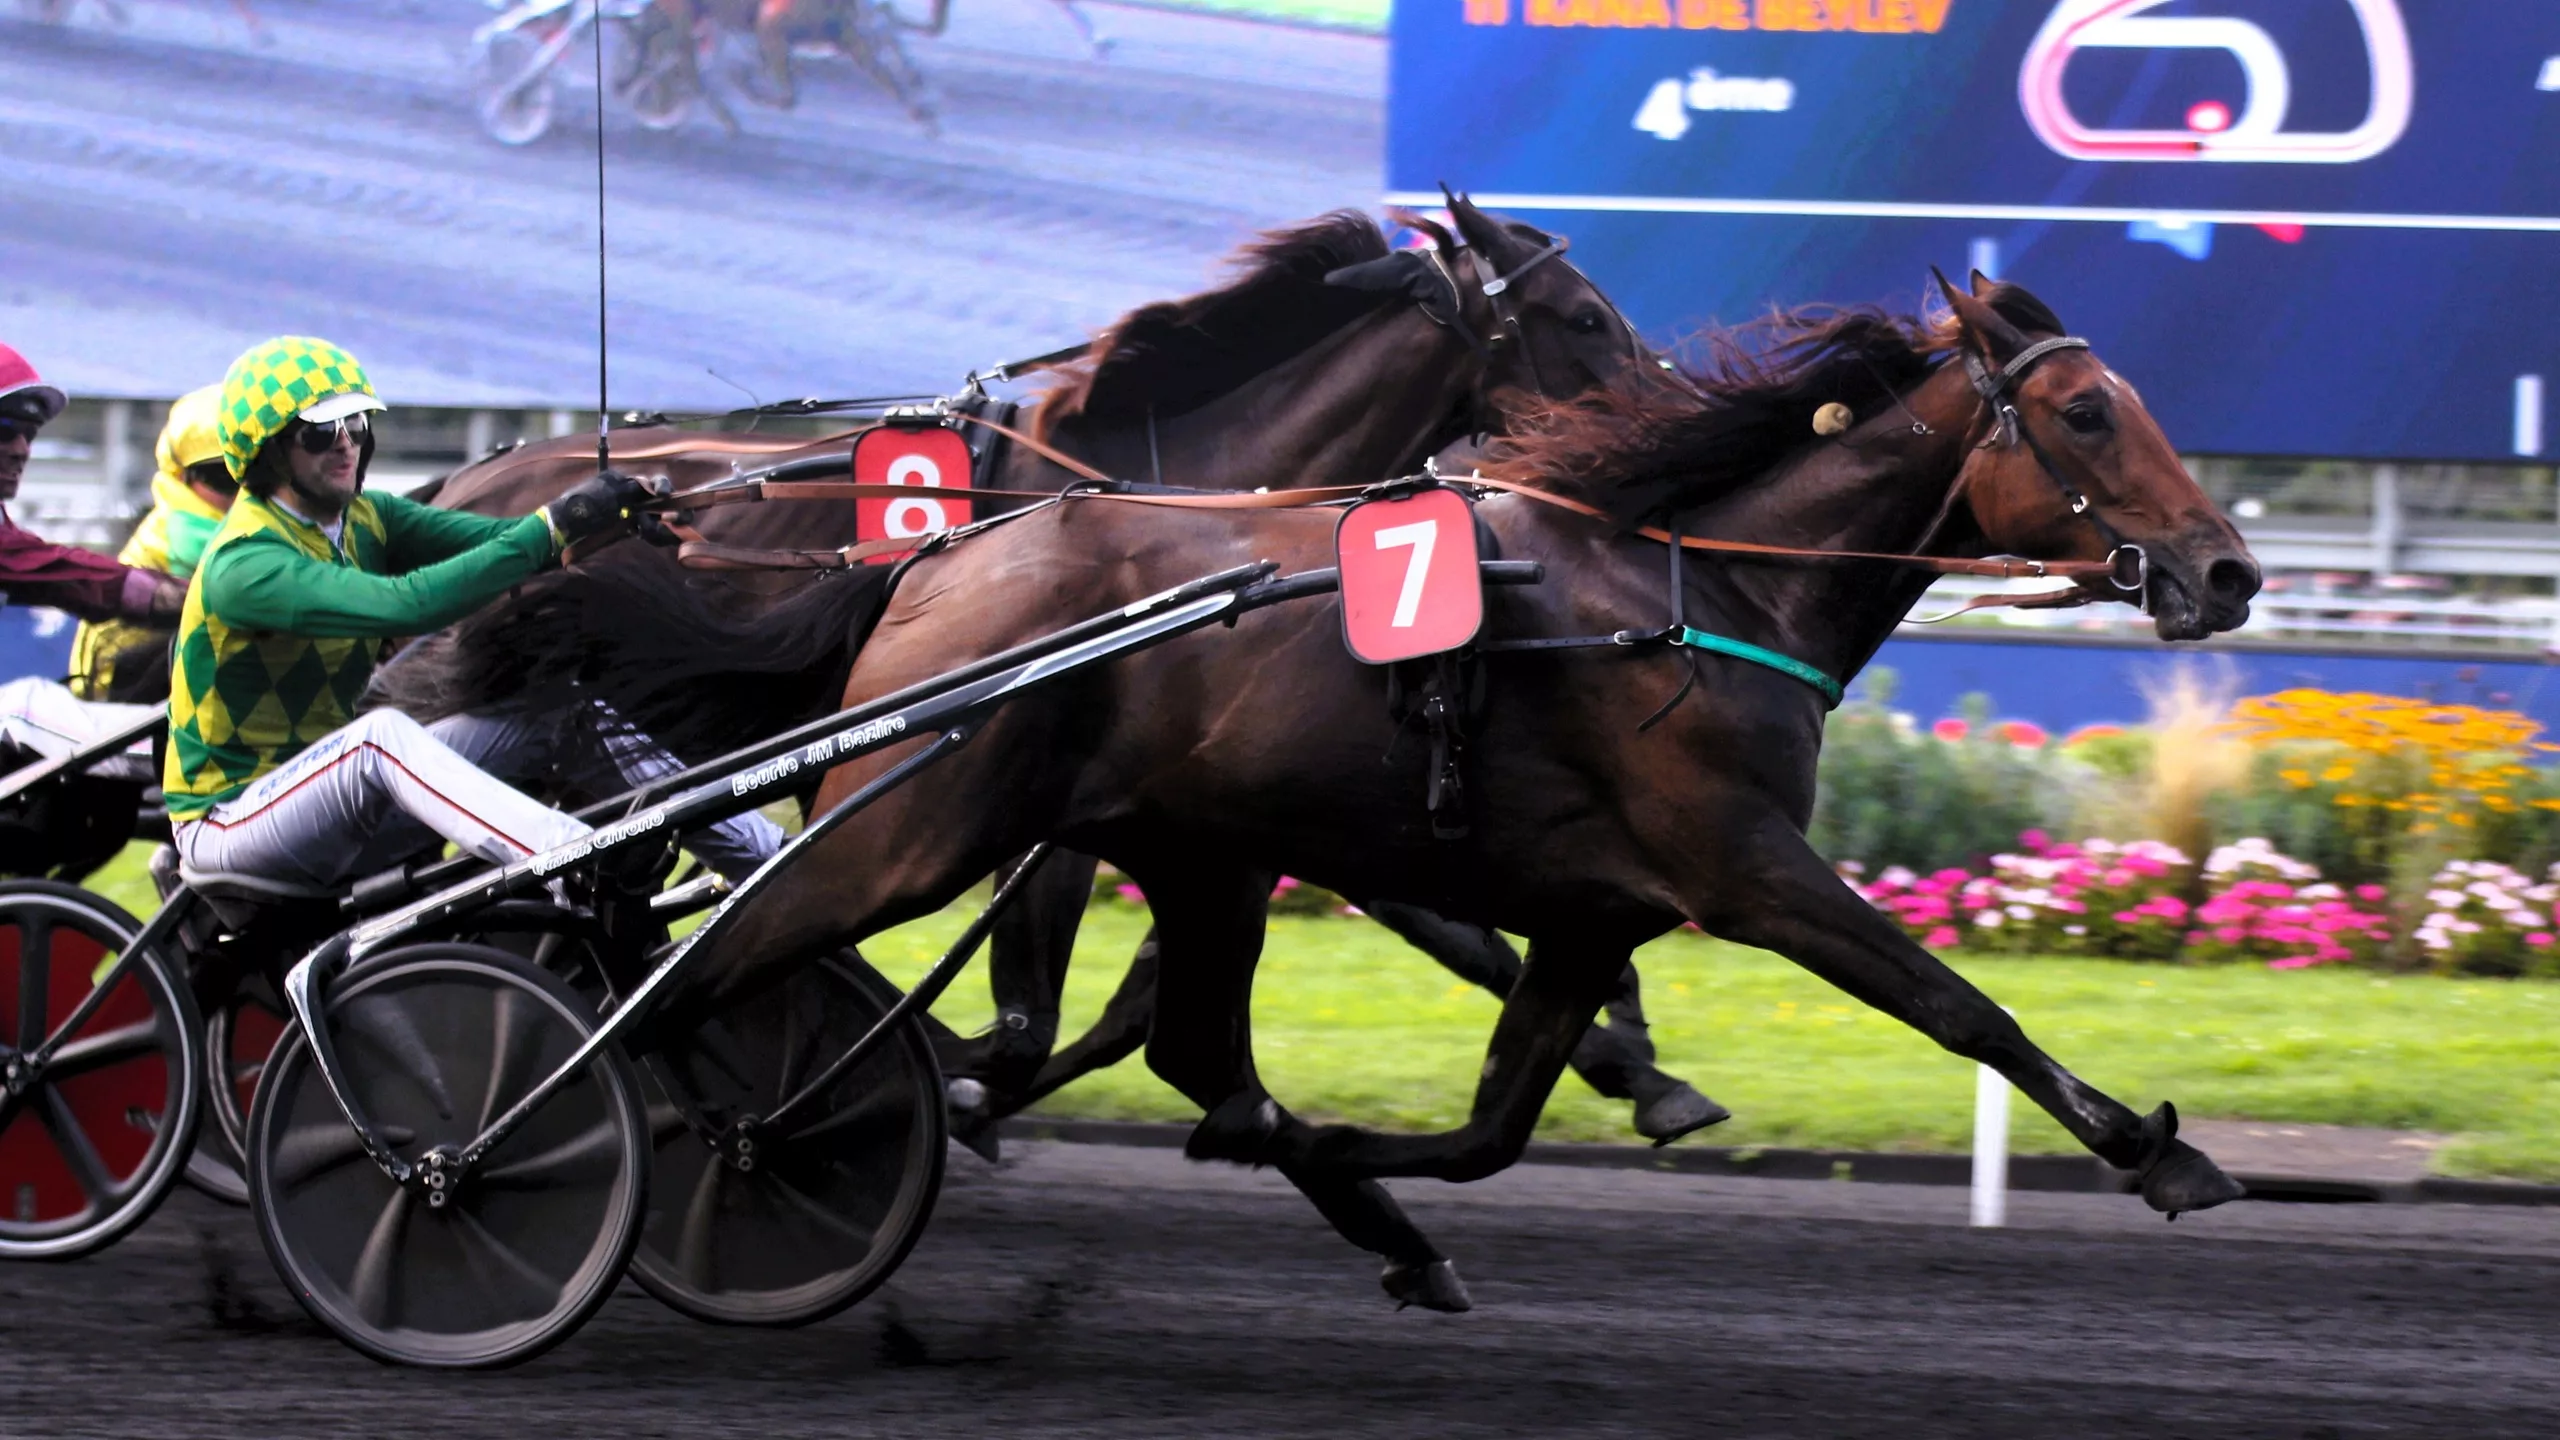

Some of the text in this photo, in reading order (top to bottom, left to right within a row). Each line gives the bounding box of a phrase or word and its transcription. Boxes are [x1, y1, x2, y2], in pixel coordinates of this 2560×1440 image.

[883, 453, 946, 540] 8
[1374, 519, 1437, 628] 7
[732, 756, 799, 797] Ecurie
[838, 716, 907, 753] Bazire
[593, 809, 665, 849] Chrono
